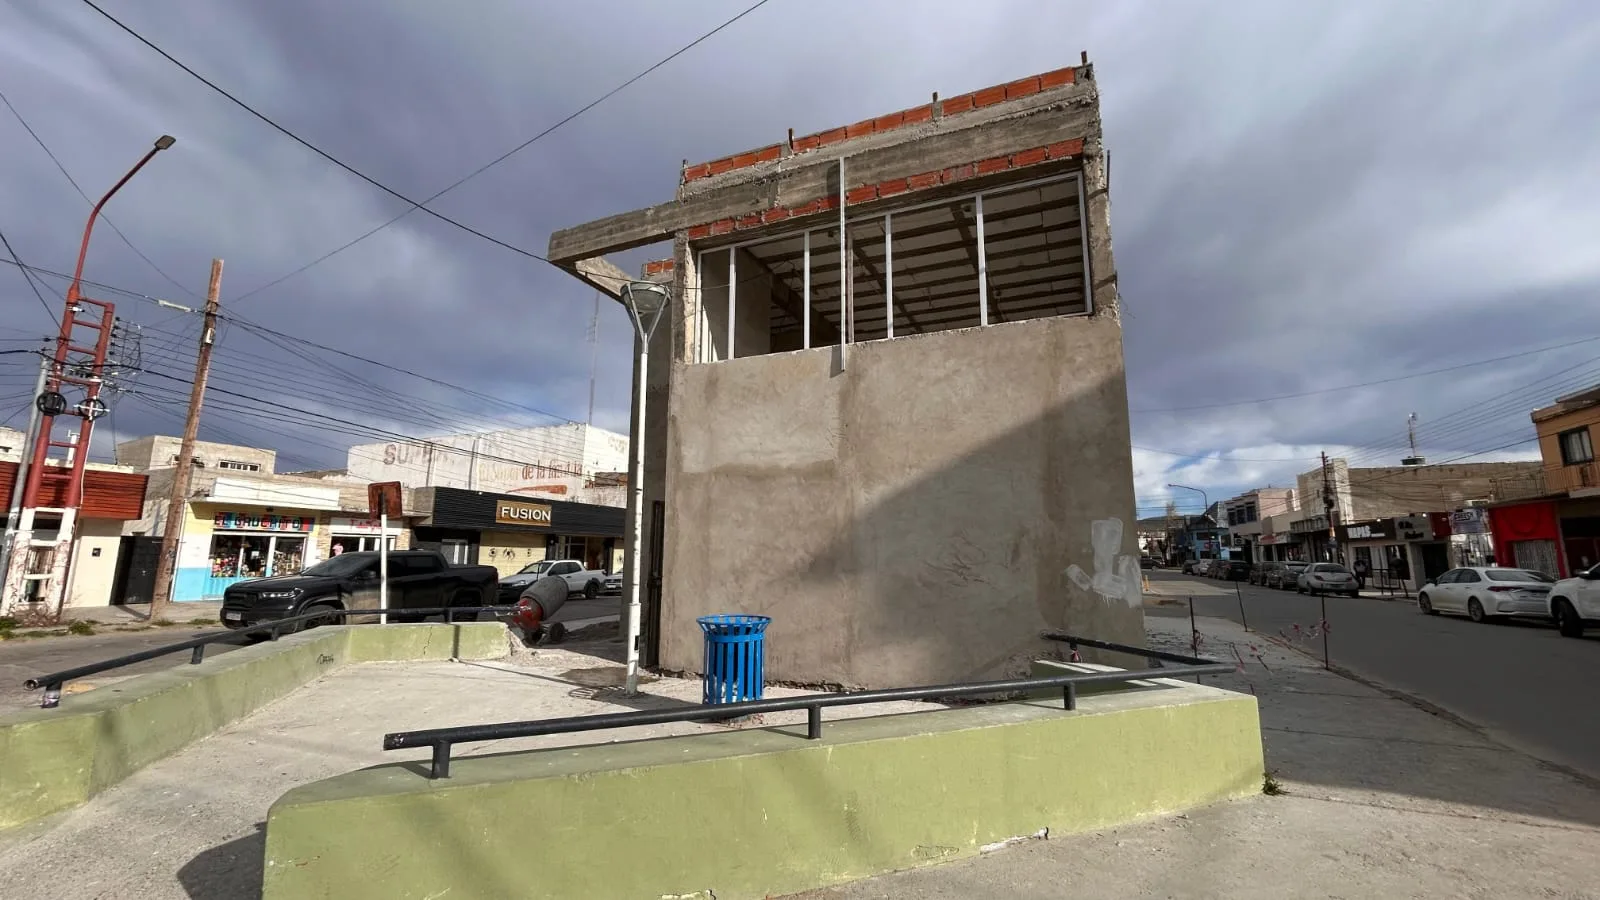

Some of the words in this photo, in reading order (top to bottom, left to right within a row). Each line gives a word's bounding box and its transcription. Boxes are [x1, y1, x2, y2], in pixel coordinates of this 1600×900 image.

[521, 464, 534, 480] de
[536, 459, 546, 479] la
[501, 506, 552, 521] FUSION
